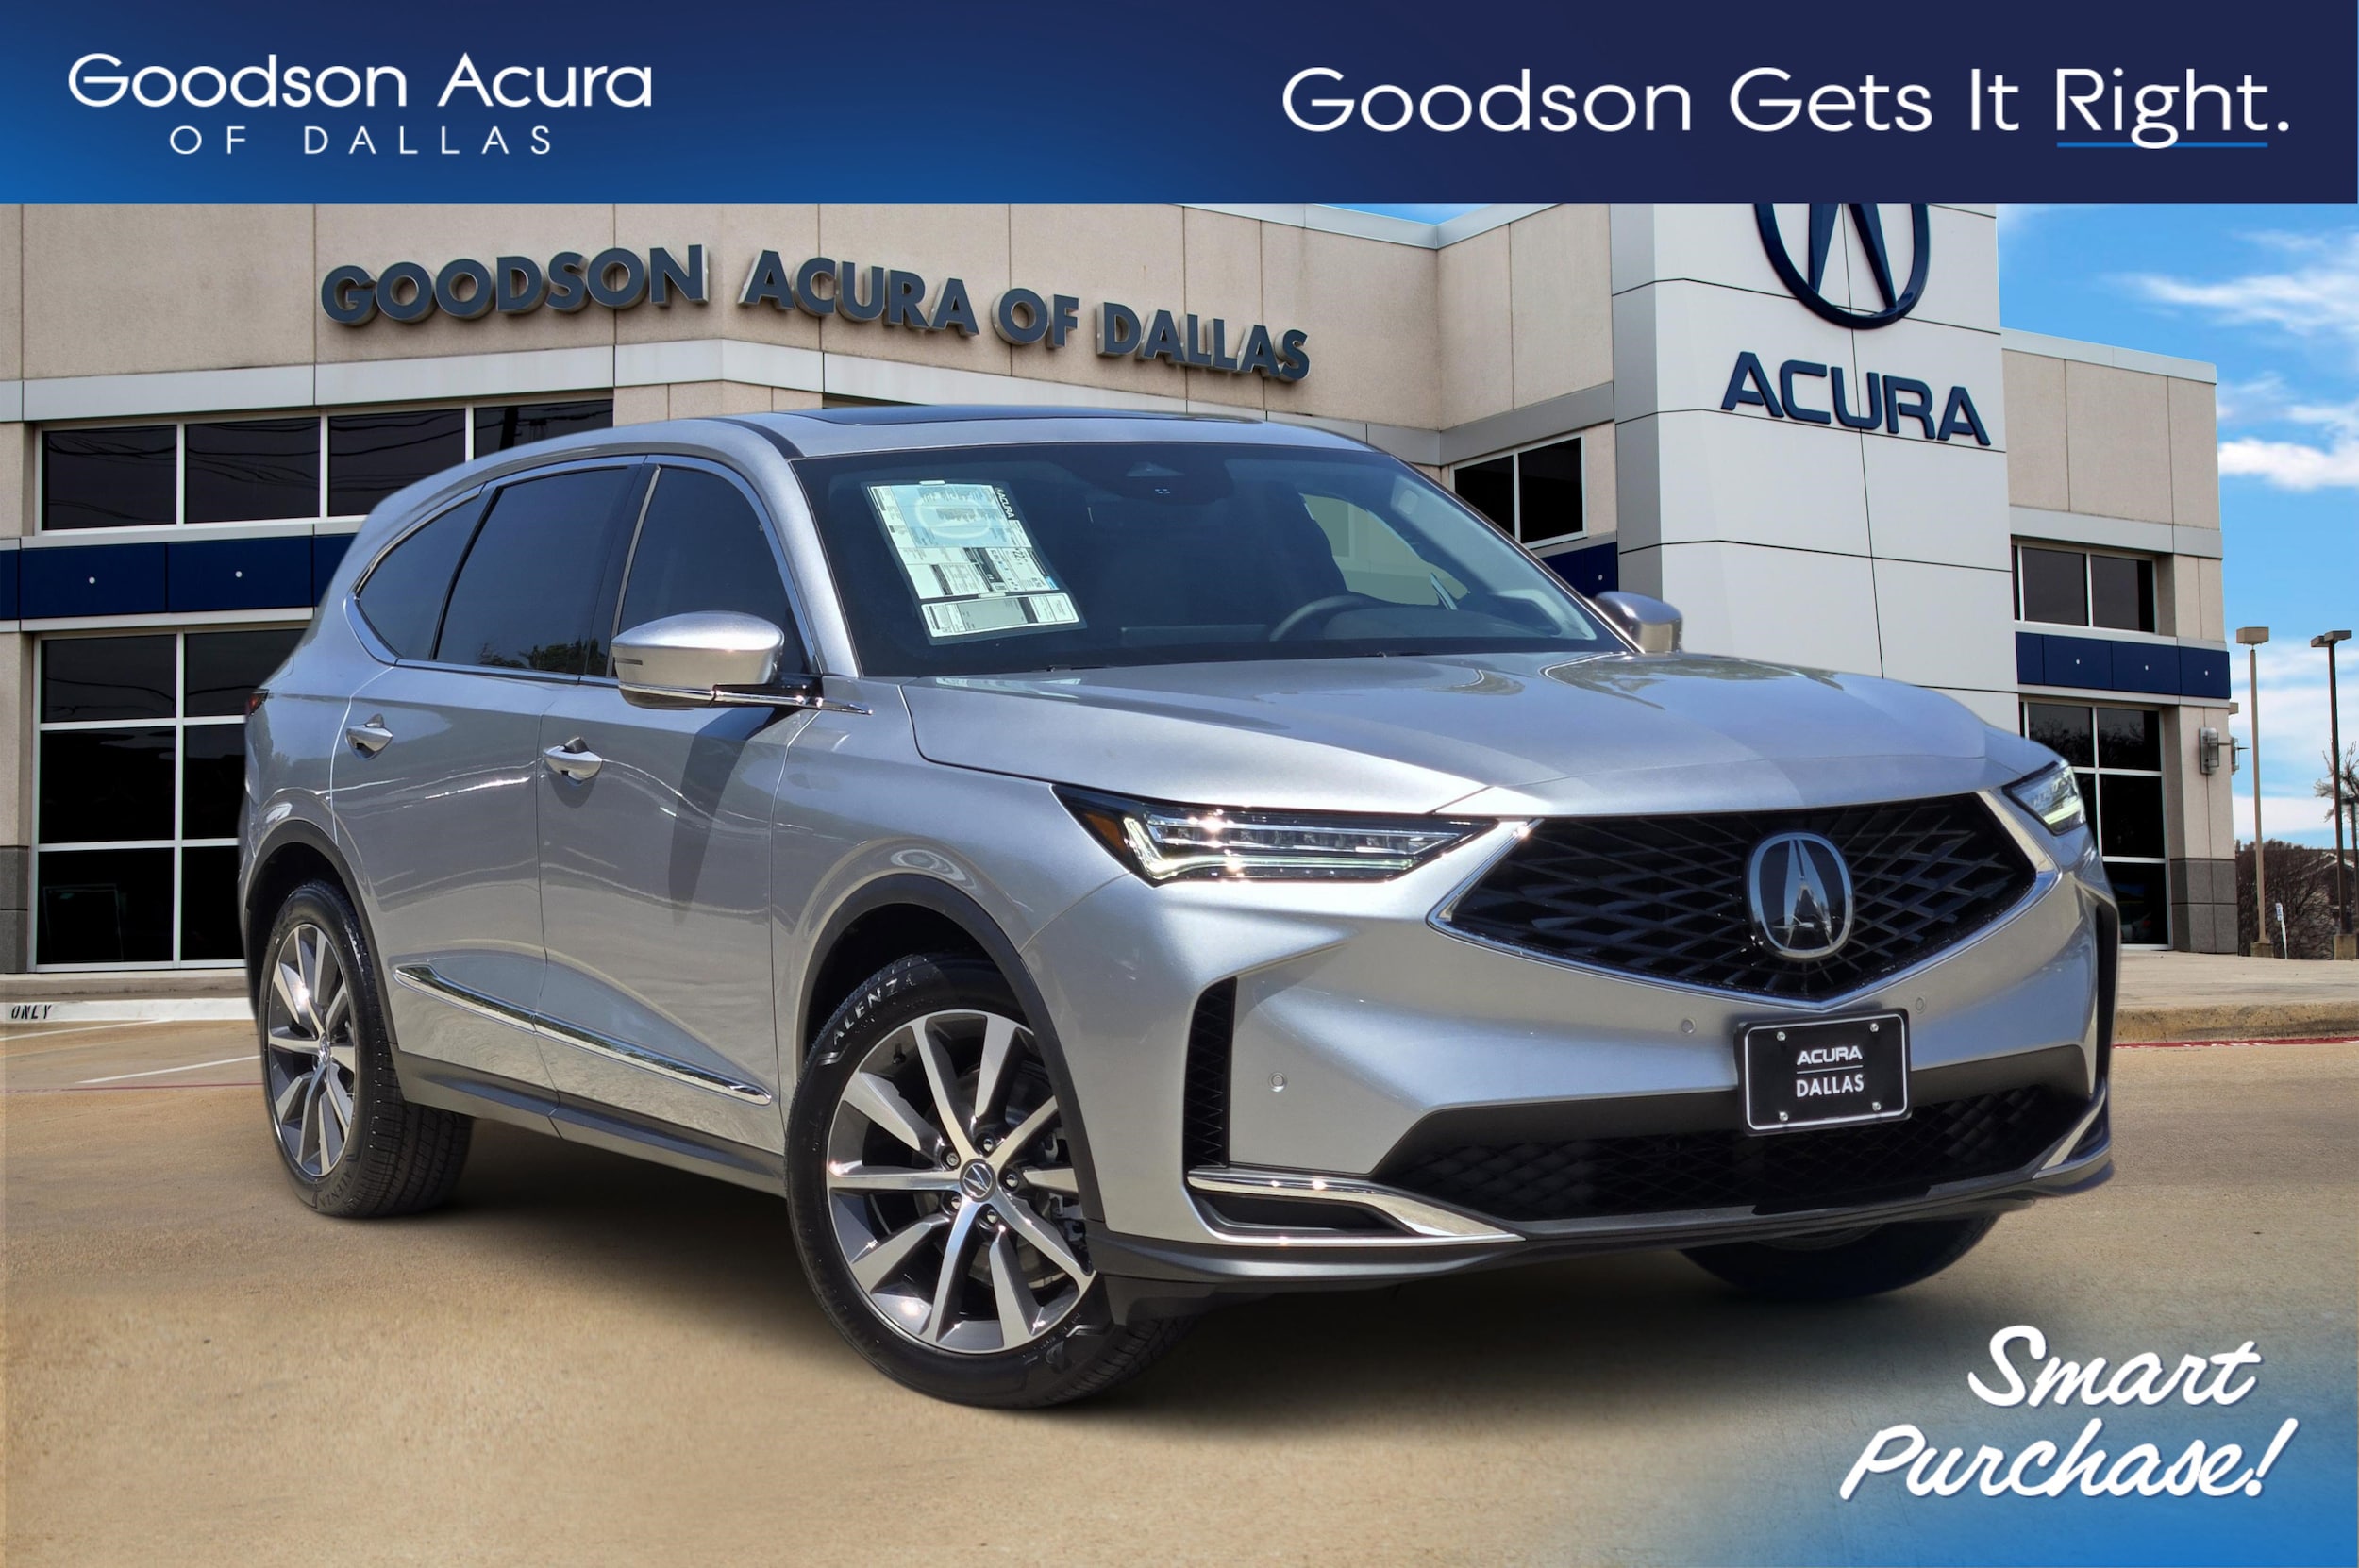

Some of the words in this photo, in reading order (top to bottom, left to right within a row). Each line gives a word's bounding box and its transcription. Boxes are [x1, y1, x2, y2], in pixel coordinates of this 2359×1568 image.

[321, 244, 709, 327] GOODSON
[739, 250, 979, 337] ACURA
[993, 288, 1079, 348] OF
[1096, 301, 1311, 382] DALLAS
[1720, 351, 1992, 446] ACURA
[996, 492, 1015, 519] ACURA
[11, 1004, 52, 1019] ONLY
[831, 972, 917, 1047] ALENZA
[1797, 1045, 1863, 1066] ACURA
[1796, 1074, 1865, 1098] DALLAS
